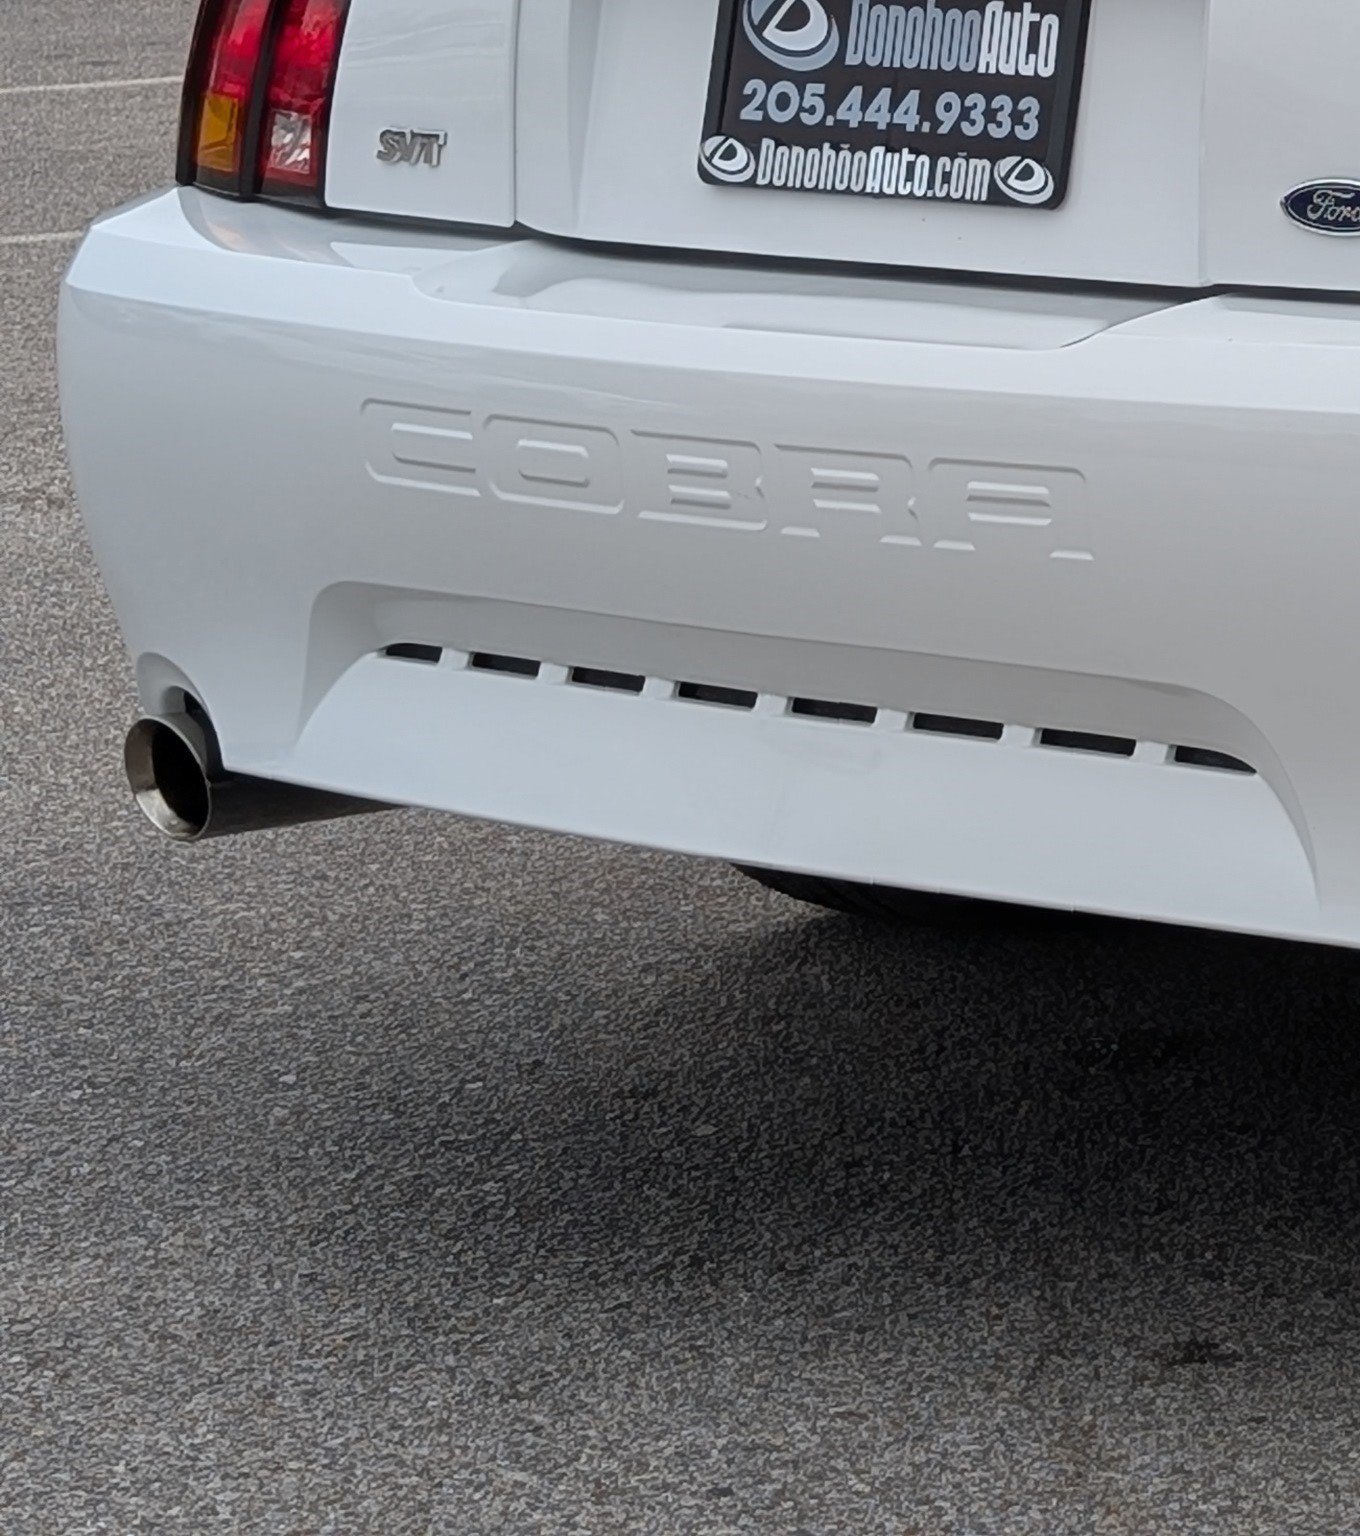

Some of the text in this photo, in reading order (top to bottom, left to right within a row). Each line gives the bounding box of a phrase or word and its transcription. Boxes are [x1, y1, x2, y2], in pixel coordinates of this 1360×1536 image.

[739, 78, 1040, 141] 205.444.9333
[376, 128, 448, 168] SVT
[755, 137, 992, 202] DonohooAuto.com
[360, 397, 1095, 561] COBRA
